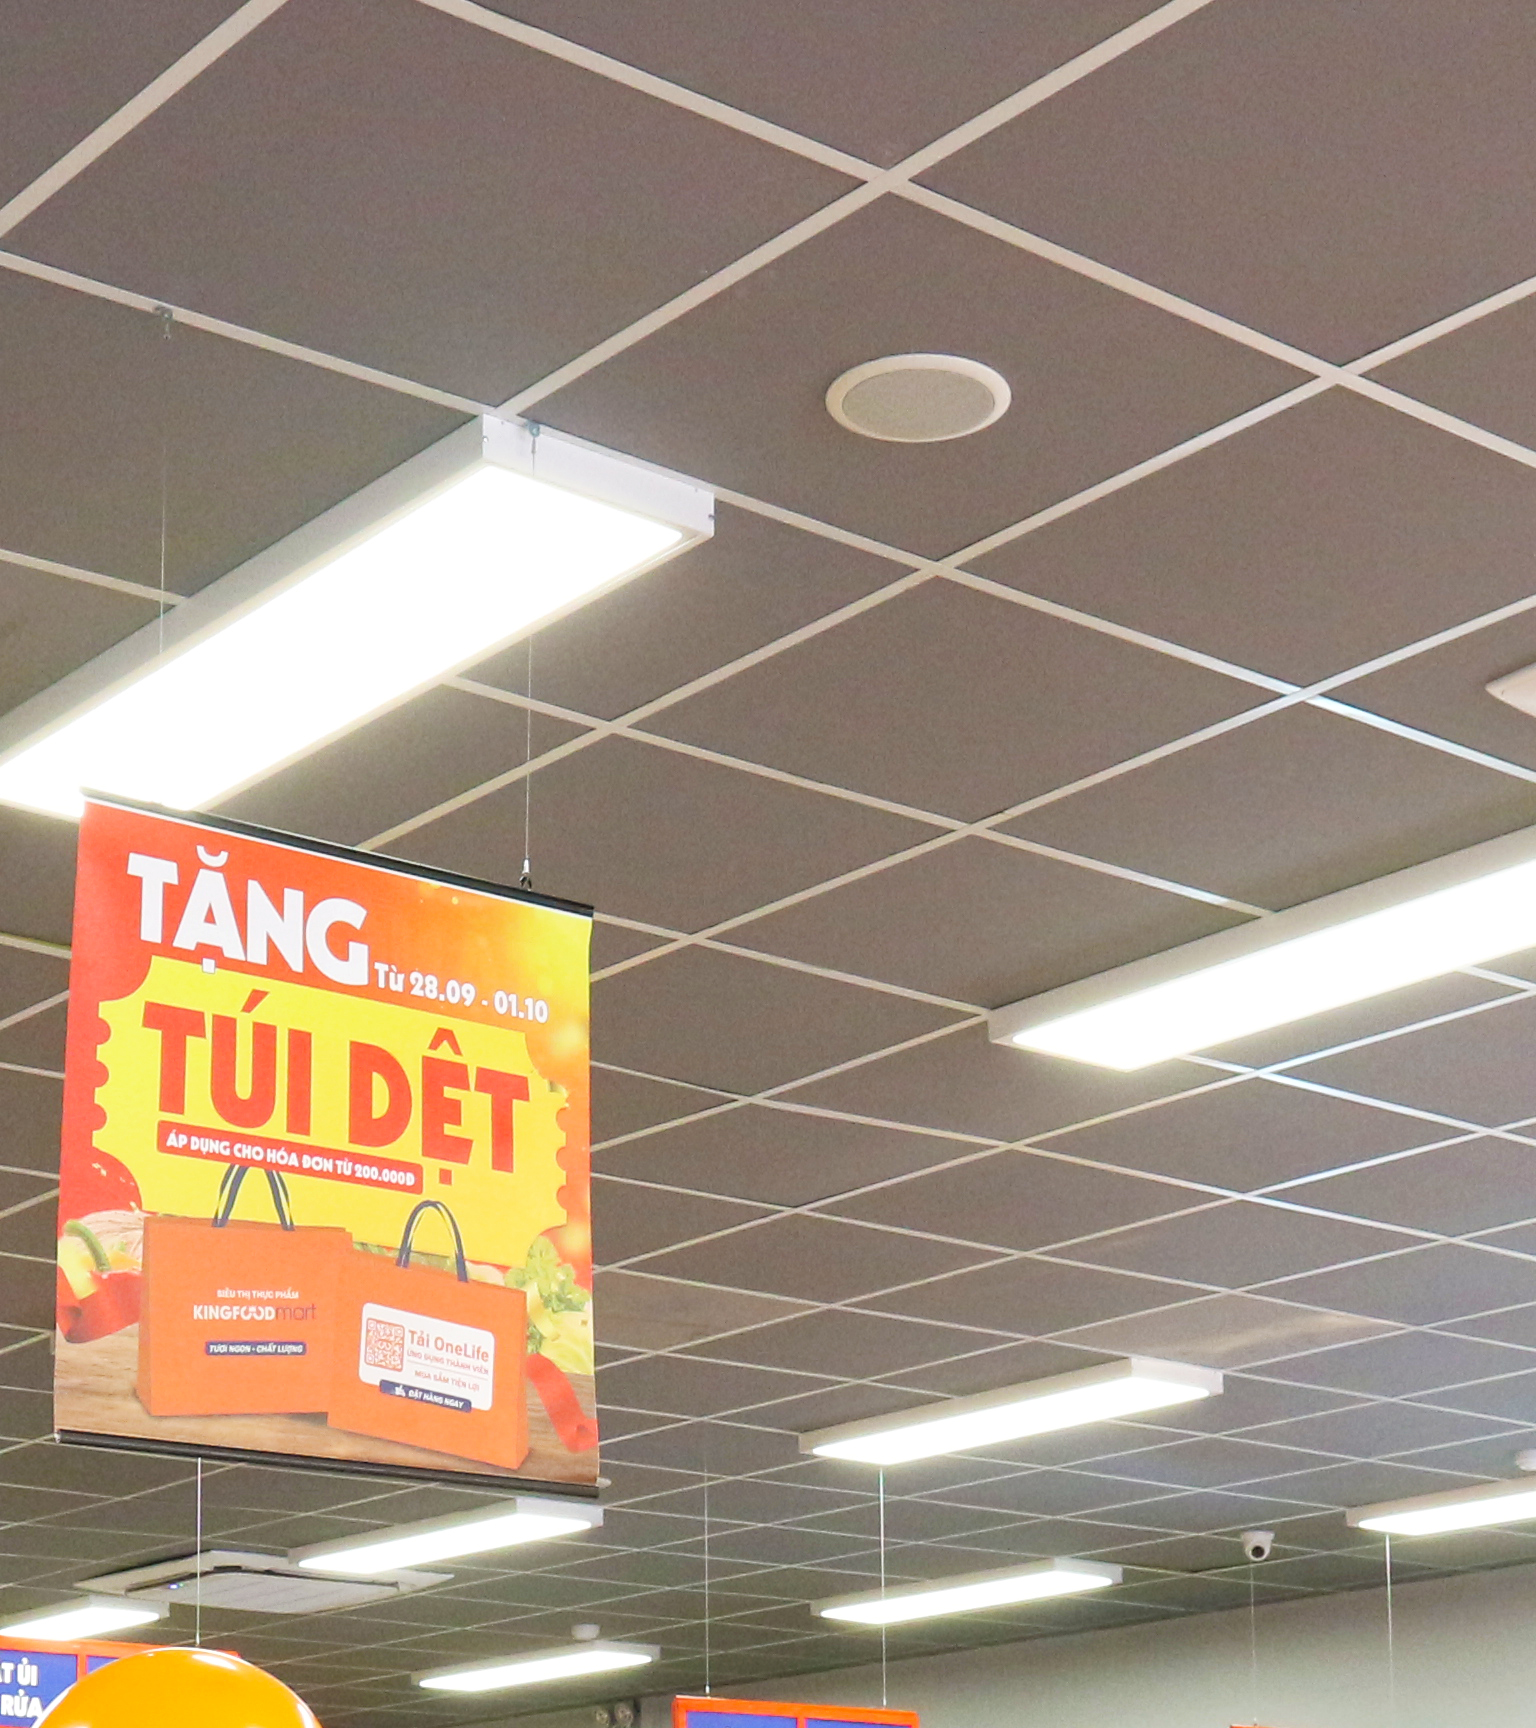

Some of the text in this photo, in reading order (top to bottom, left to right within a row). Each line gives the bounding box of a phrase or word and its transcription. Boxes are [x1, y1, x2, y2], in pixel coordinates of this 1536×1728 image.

[127, 845, 369, 985] TẶNG
[374, 960, 549, 1023] Từ 28.09 01.10
[142, 989, 531, 1186] TÚI DỆT
[166, 1130, 415, 1186] ÁP DỤNG CHO HÓA ĐƠN TỪ 200.000Đ
[193, 1304, 317, 1320] KINGFOODmart
[408, 1331, 489, 1362] Tải OneLife
[17, 1659, 39, 1687] ỦI
[1, 1689, 44, 1719] RỬA
